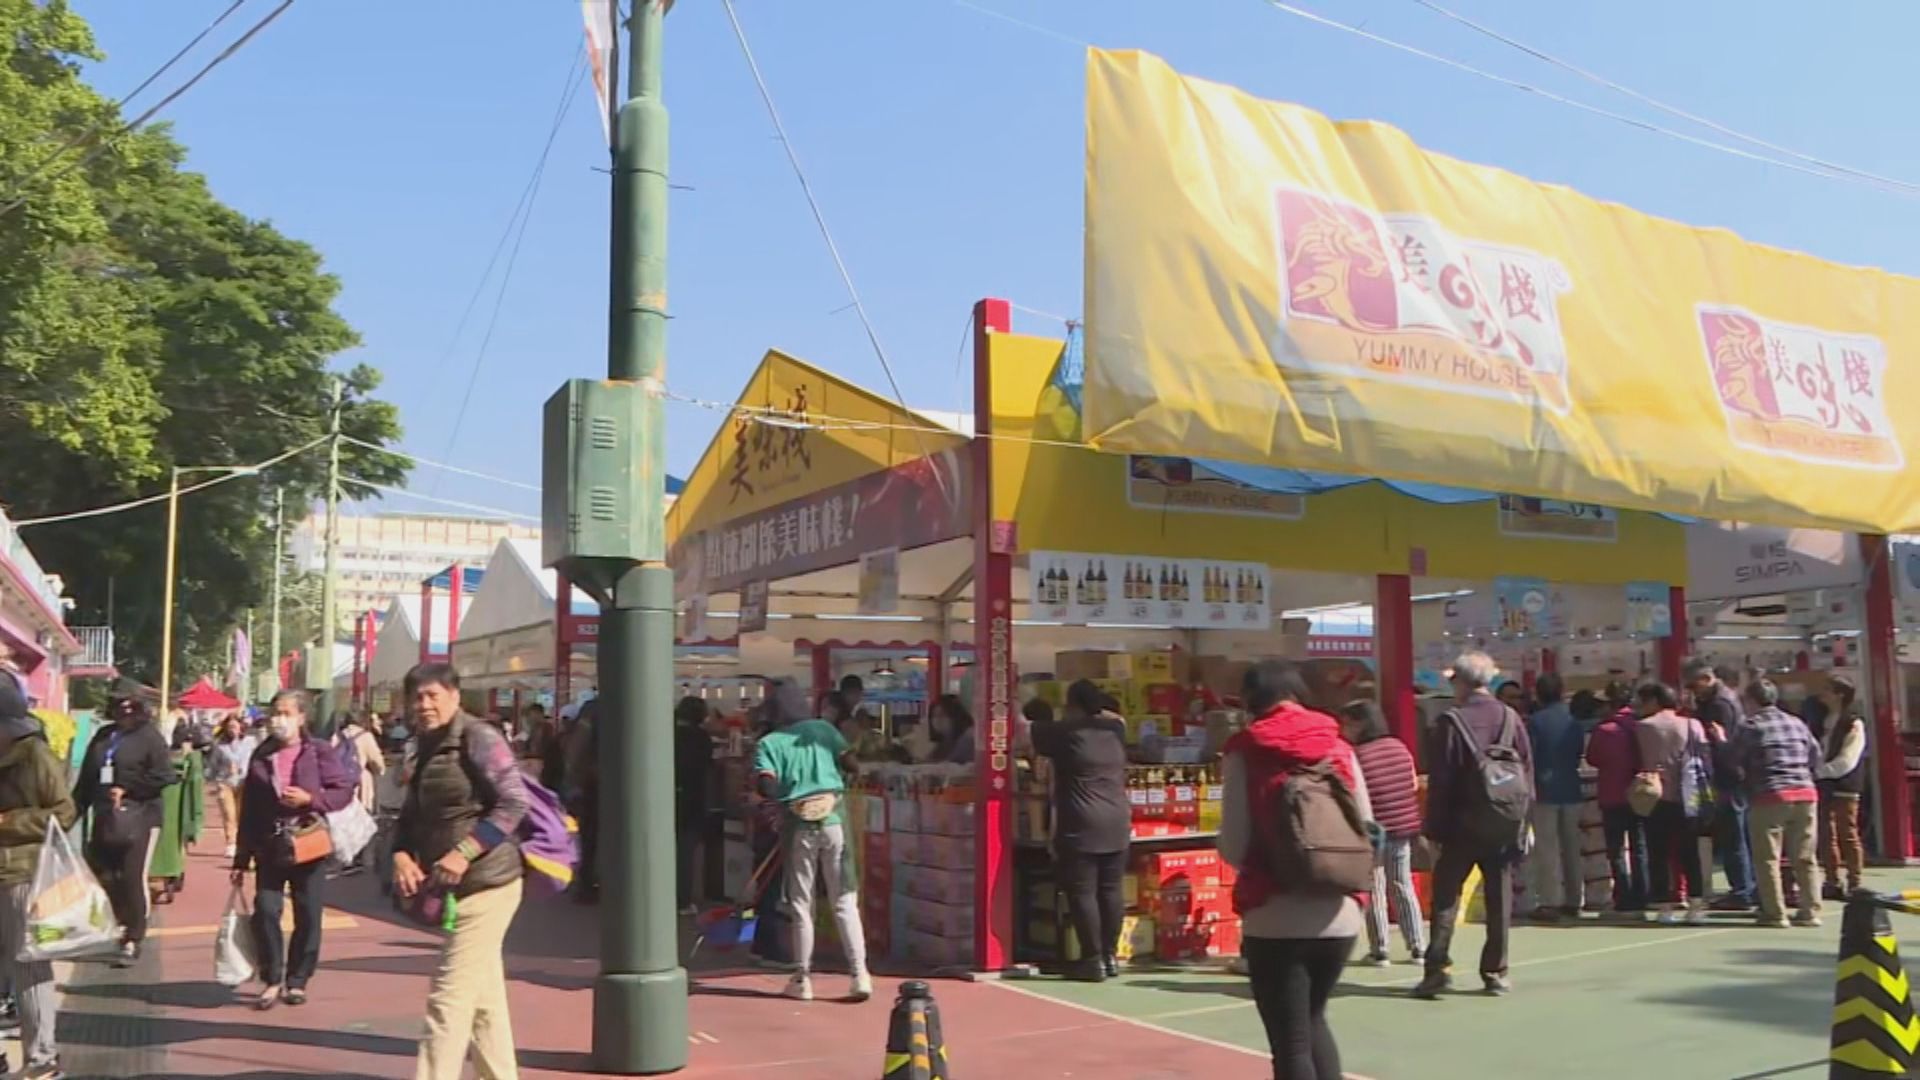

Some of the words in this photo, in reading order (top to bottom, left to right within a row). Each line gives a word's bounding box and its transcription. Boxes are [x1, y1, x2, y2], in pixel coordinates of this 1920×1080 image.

[1353, 337, 1443, 373] YUMMY
[1451, 355, 1532, 390] HOUSE
[1735, 560, 1805, 583] SIMPA
